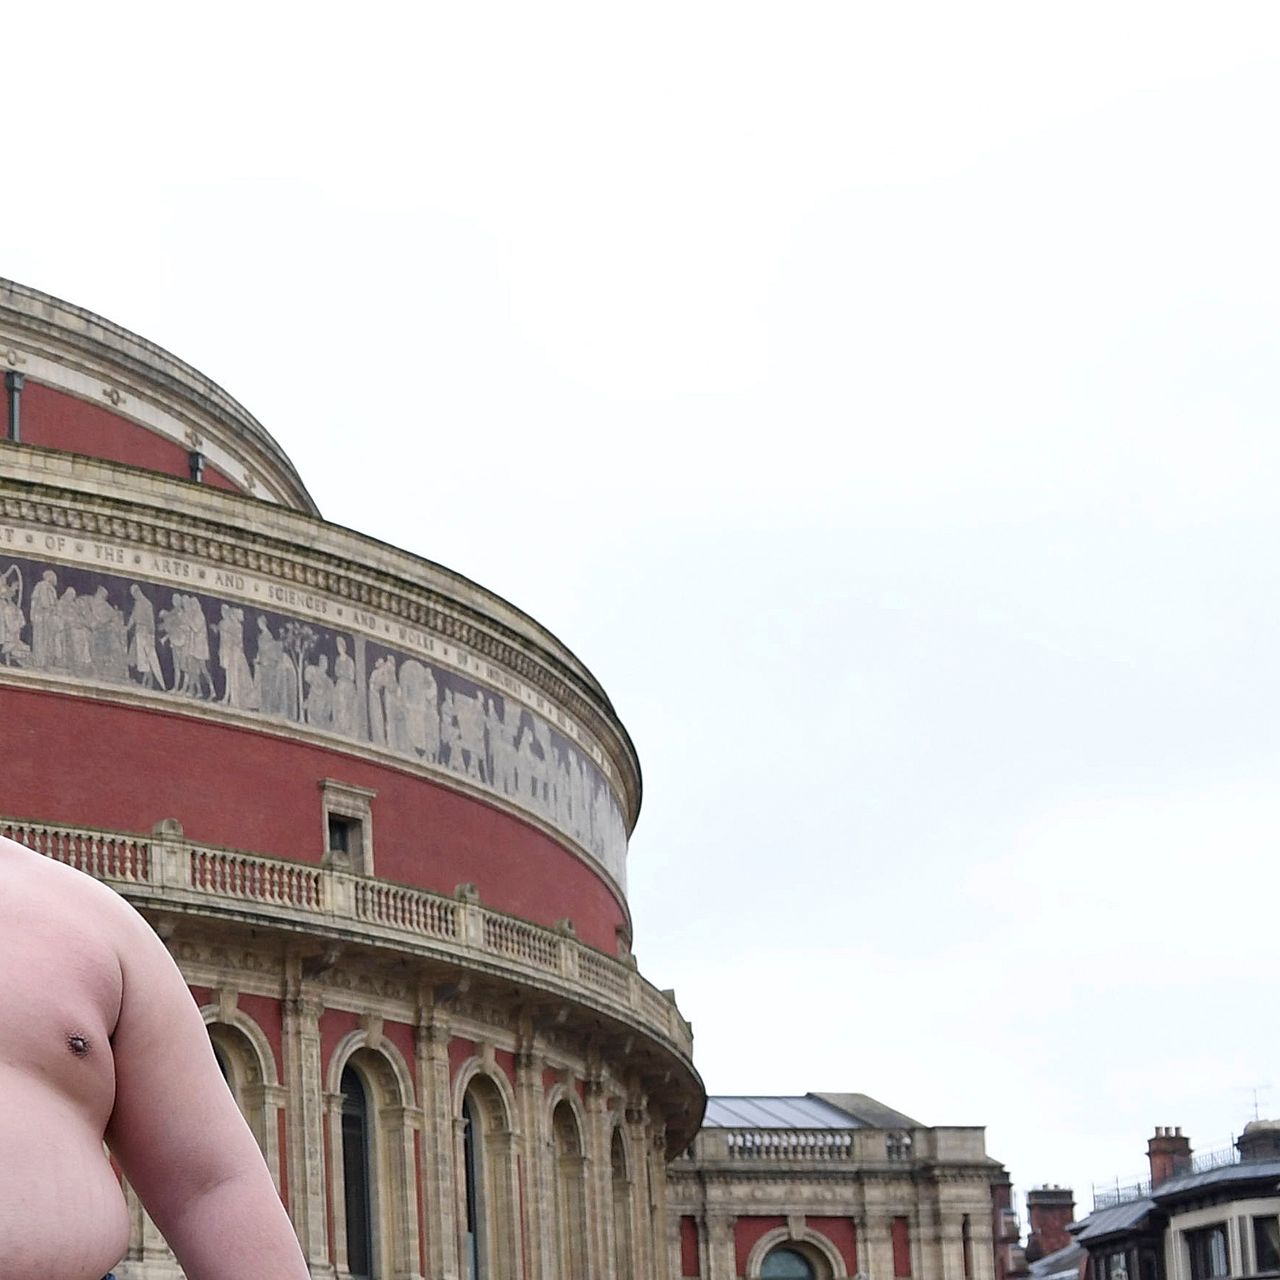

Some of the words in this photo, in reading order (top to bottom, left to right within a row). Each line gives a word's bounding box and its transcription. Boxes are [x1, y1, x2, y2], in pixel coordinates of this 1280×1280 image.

[45, 535, 66, 552] OF
[94, 545, 124, 564] THE
[151, 558, 191, 577] ARTS
[215, 574, 245, 592] AND
[268, 584, 328, 615] SCIENCES
